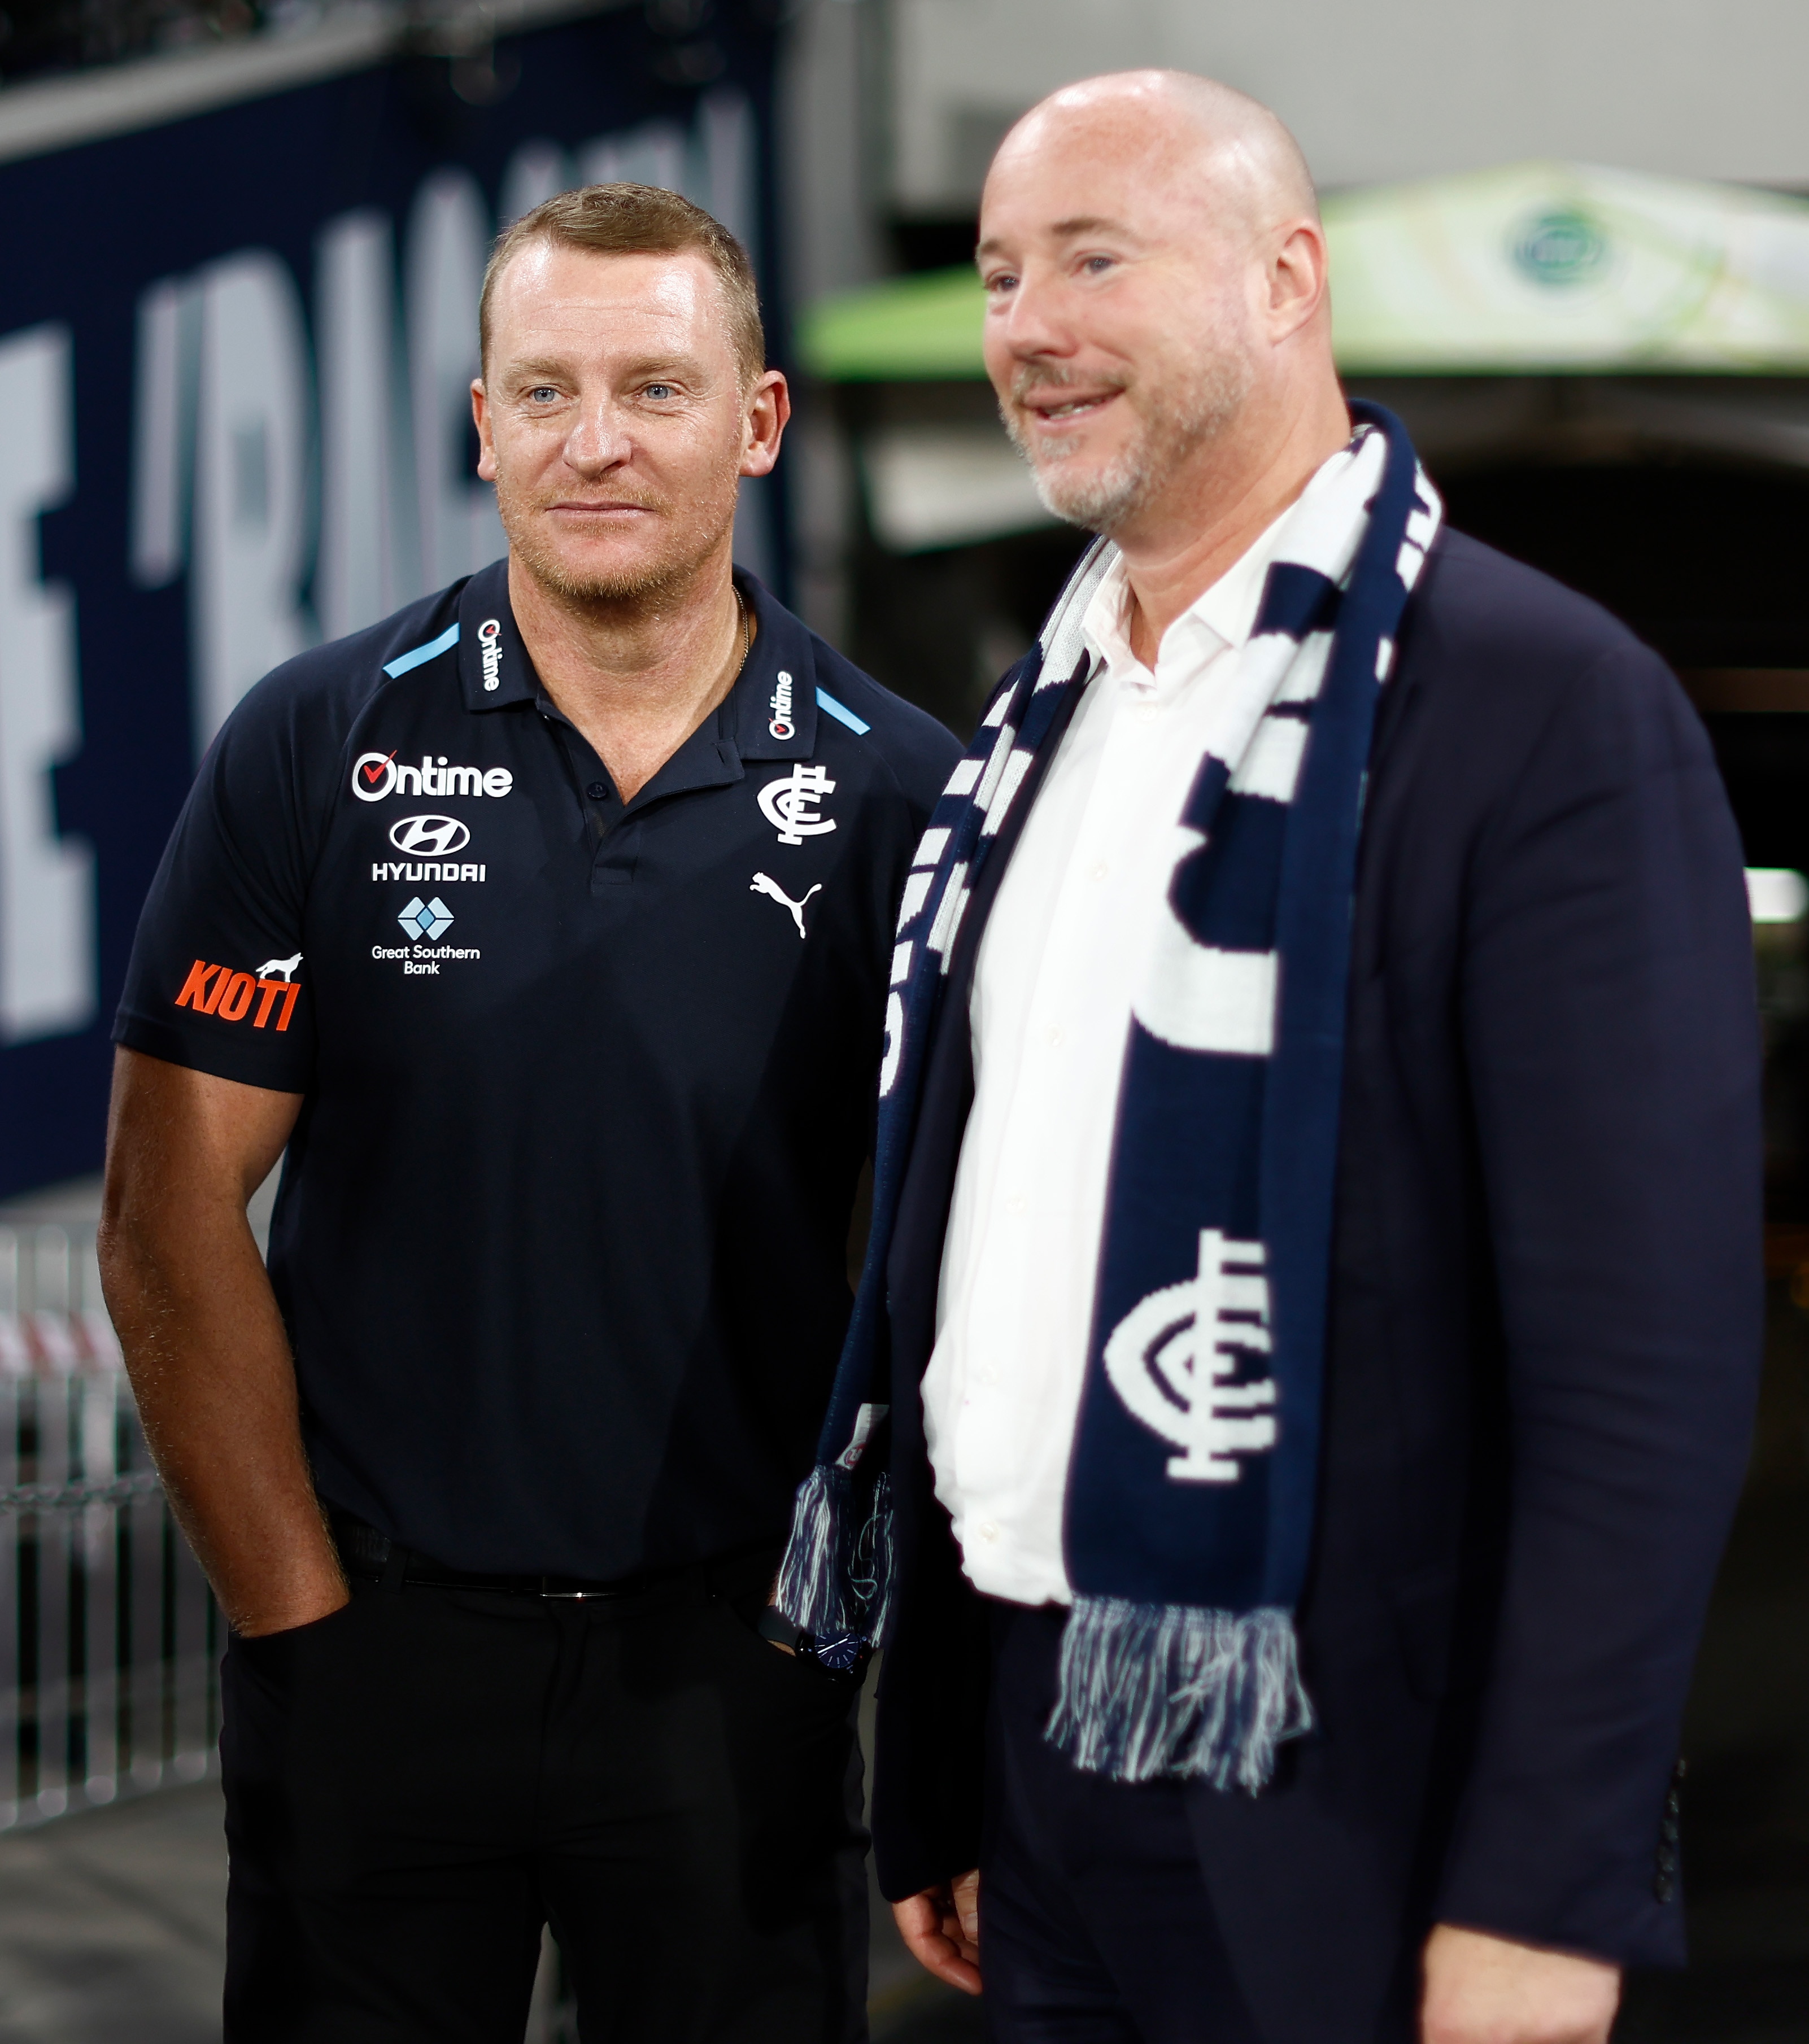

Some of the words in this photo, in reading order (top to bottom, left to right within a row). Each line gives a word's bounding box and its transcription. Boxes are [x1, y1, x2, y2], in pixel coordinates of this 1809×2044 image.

[477, 618, 503, 692] Ontime
[769, 670, 796, 740] Ontime
[351, 750, 513, 802] Ontime
[372, 863, 486, 882] HYUNDAI
[372, 945, 409, 959] Great
[413, 945, 480, 959] Southern
[404, 960, 440, 975] Bank
[175, 959, 302, 1031] KIOTI
